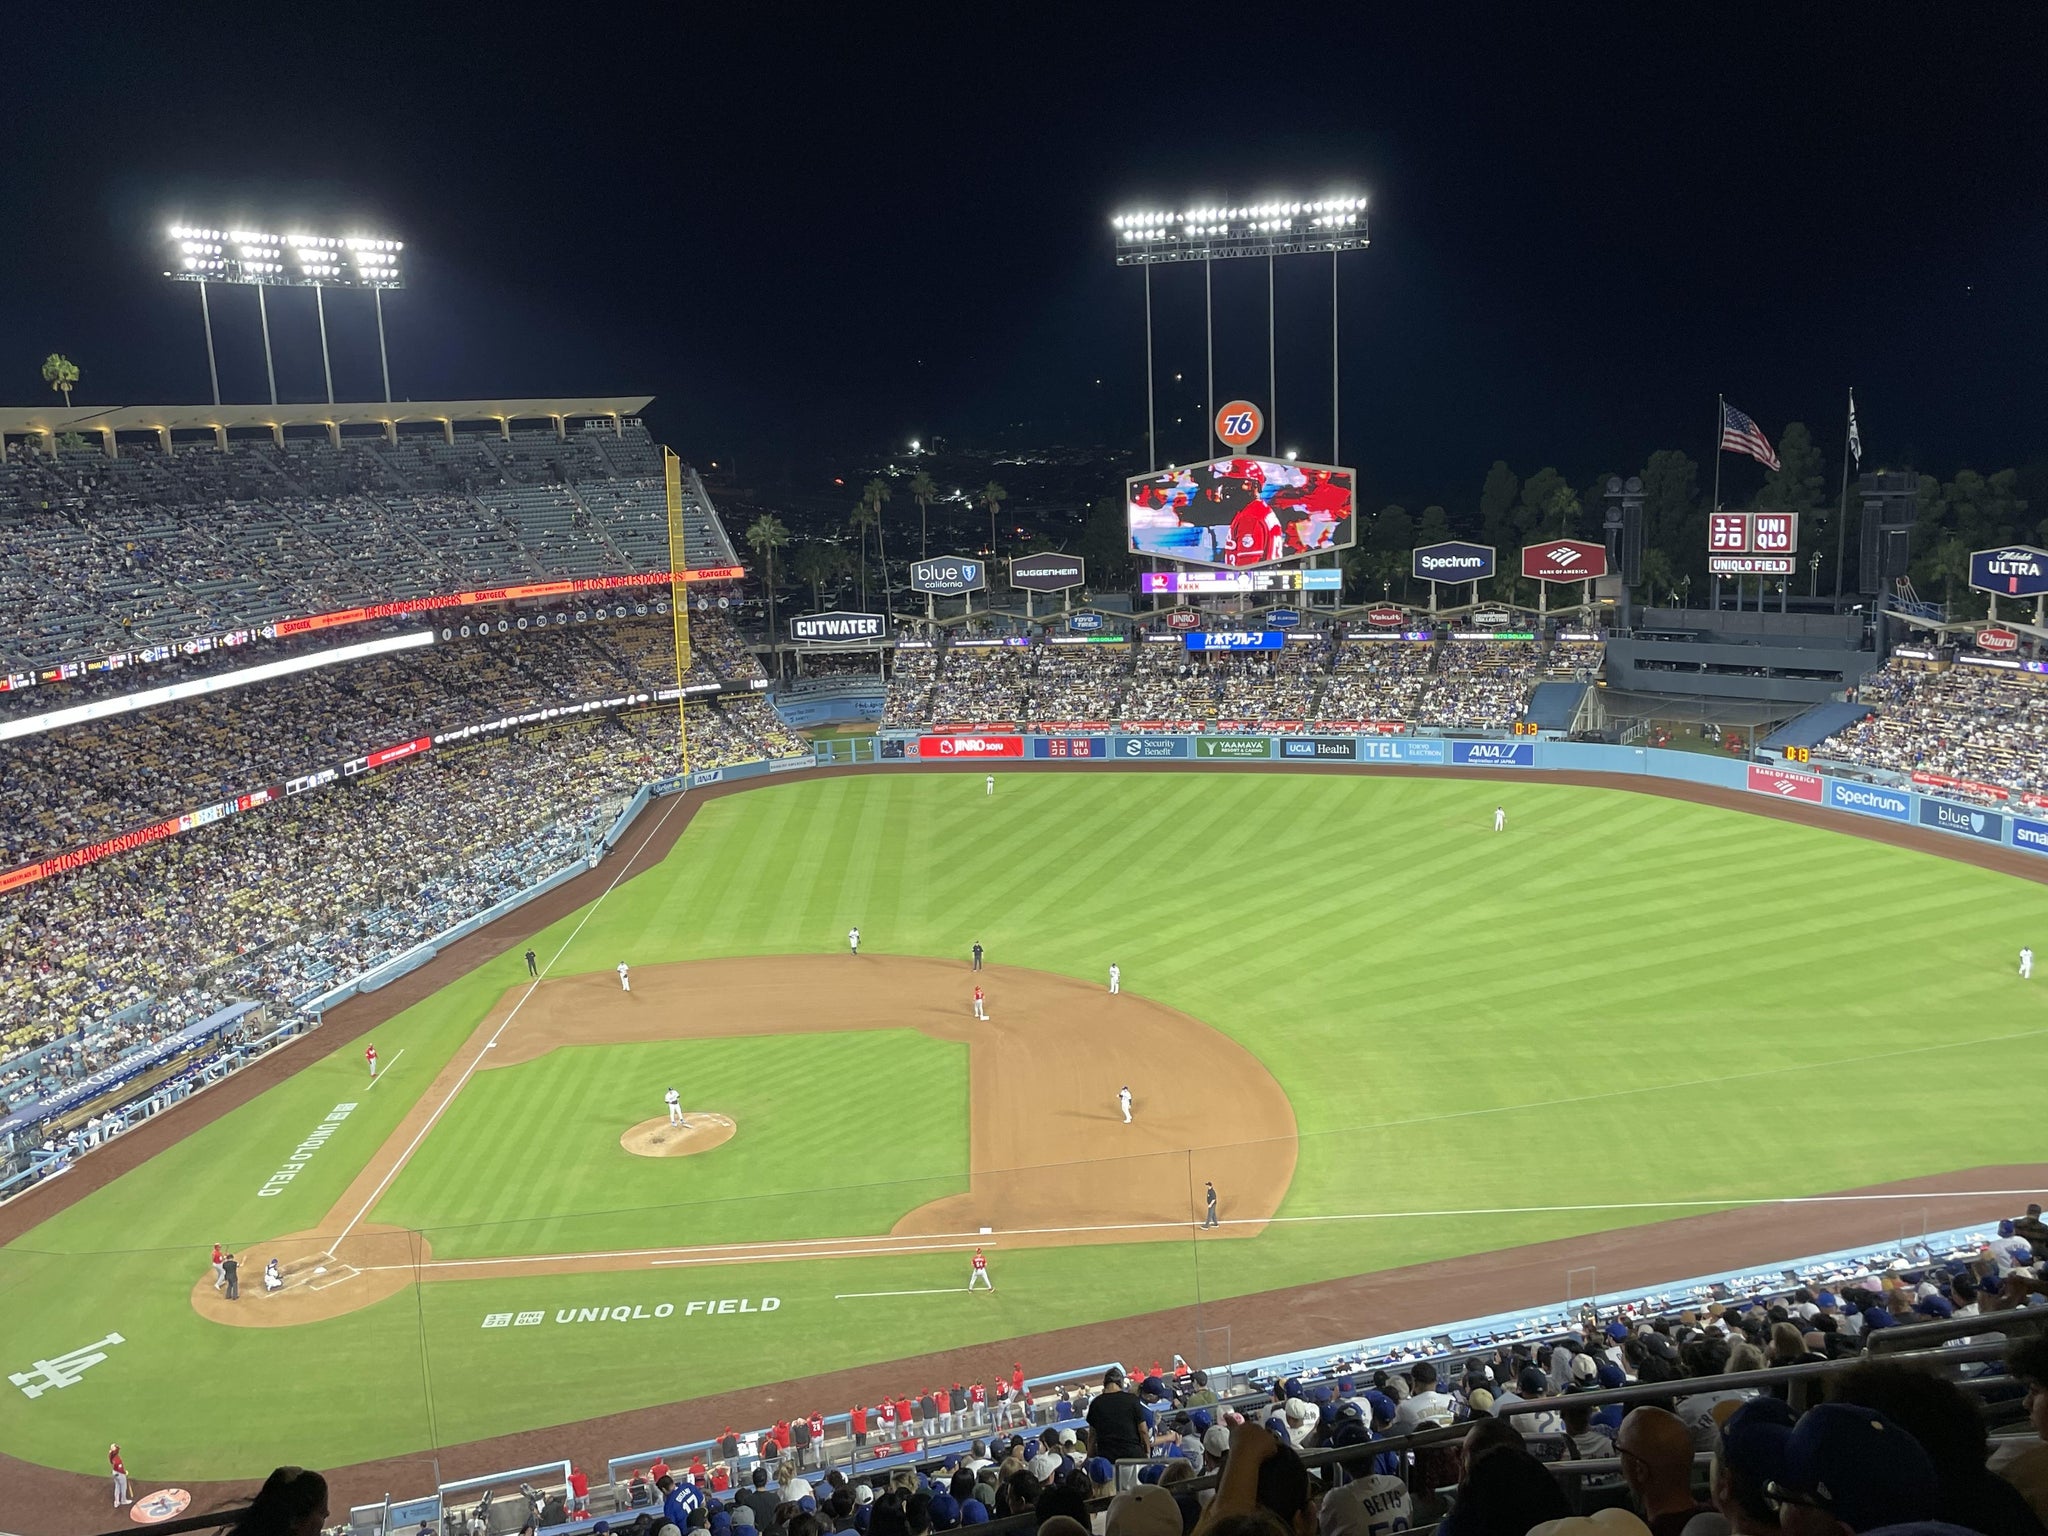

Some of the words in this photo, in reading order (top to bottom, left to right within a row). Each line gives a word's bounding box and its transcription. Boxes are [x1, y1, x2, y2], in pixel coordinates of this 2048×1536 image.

[1224, 412, 1254, 435] 76
[1758, 519, 1785, 532] UNI
[1757, 534, 1787, 549] QLO
[1421, 555, 1480, 570] Spectrum
[1713, 560, 1753, 572] UNIQLO
[1754, 561, 1787, 571] FIELD
[1988, 561, 2041, 576] ULTRA
[697, 570, 732, 579] SEATGEEK
[918, 565, 958, 581] blue
[1016, 567, 1078, 577] GUGGENHEIM
[588, 578, 604, 590] LOS
[605, 575, 641, 589] ANGELES
[924, 580, 963, 589] california
[475, 590, 507, 601] SEATGEEK
[376, 604, 391, 618] LOS
[392, 599, 425, 615] ANGELES
[425, 594, 461, 609] DODGERS
[1173, 614, 1195, 624] JINRO
[1371, 613, 1401, 621] Yakult
[283, 620, 311, 634] SEATGEEK
[797, 618, 878, 636] CUTWATER
[1979, 632, 2016, 648] Churu
[1515, 723, 1538, 736] 0:13
[907, 745, 918, 754] 76
[954, 740, 985, 755] JINRO
[1144, 739, 1175, 749] Security
[1144, 747, 1172, 756] Benefit
[1290, 745, 1312, 753] UCLA
[1318, 744, 1350, 754] Health
[1366, 742, 1402, 758] TEL
[1469, 744, 1501, 757] ANA
[1073, 748, 1089, 756] QLO
[1409, 749, 1442, 757] ELECTRON
[1787, 746, 1809, 763] 0:13
[1755, 768, 1774, 776] BANK
[1784, 774, 1815, 784] AMERICA
[1836, 786, 1901, 812] Spectrum
[1939, 806, 1970, 826] blue
[2017, 828, 2048, 846] sma
[38, 857, 59, 877] THE
[61, 852, 80, 871] LOS
[81, 837, 125, 864] ANGELES
[125, 822, 171, 847] DODGERS
[289, 1123, 341, 1160] UNIQLO
[257, 1163, 306, 1197] FIELD
[555, 1303, 675, 1323] UNIQLO
[684, 1297, 781, 1316] FIELD
[8, 1332, 126, 1399] LA
[683, 1494, 699, 1514] 17
[1363, 1490, 1402, 1517] BETTS
